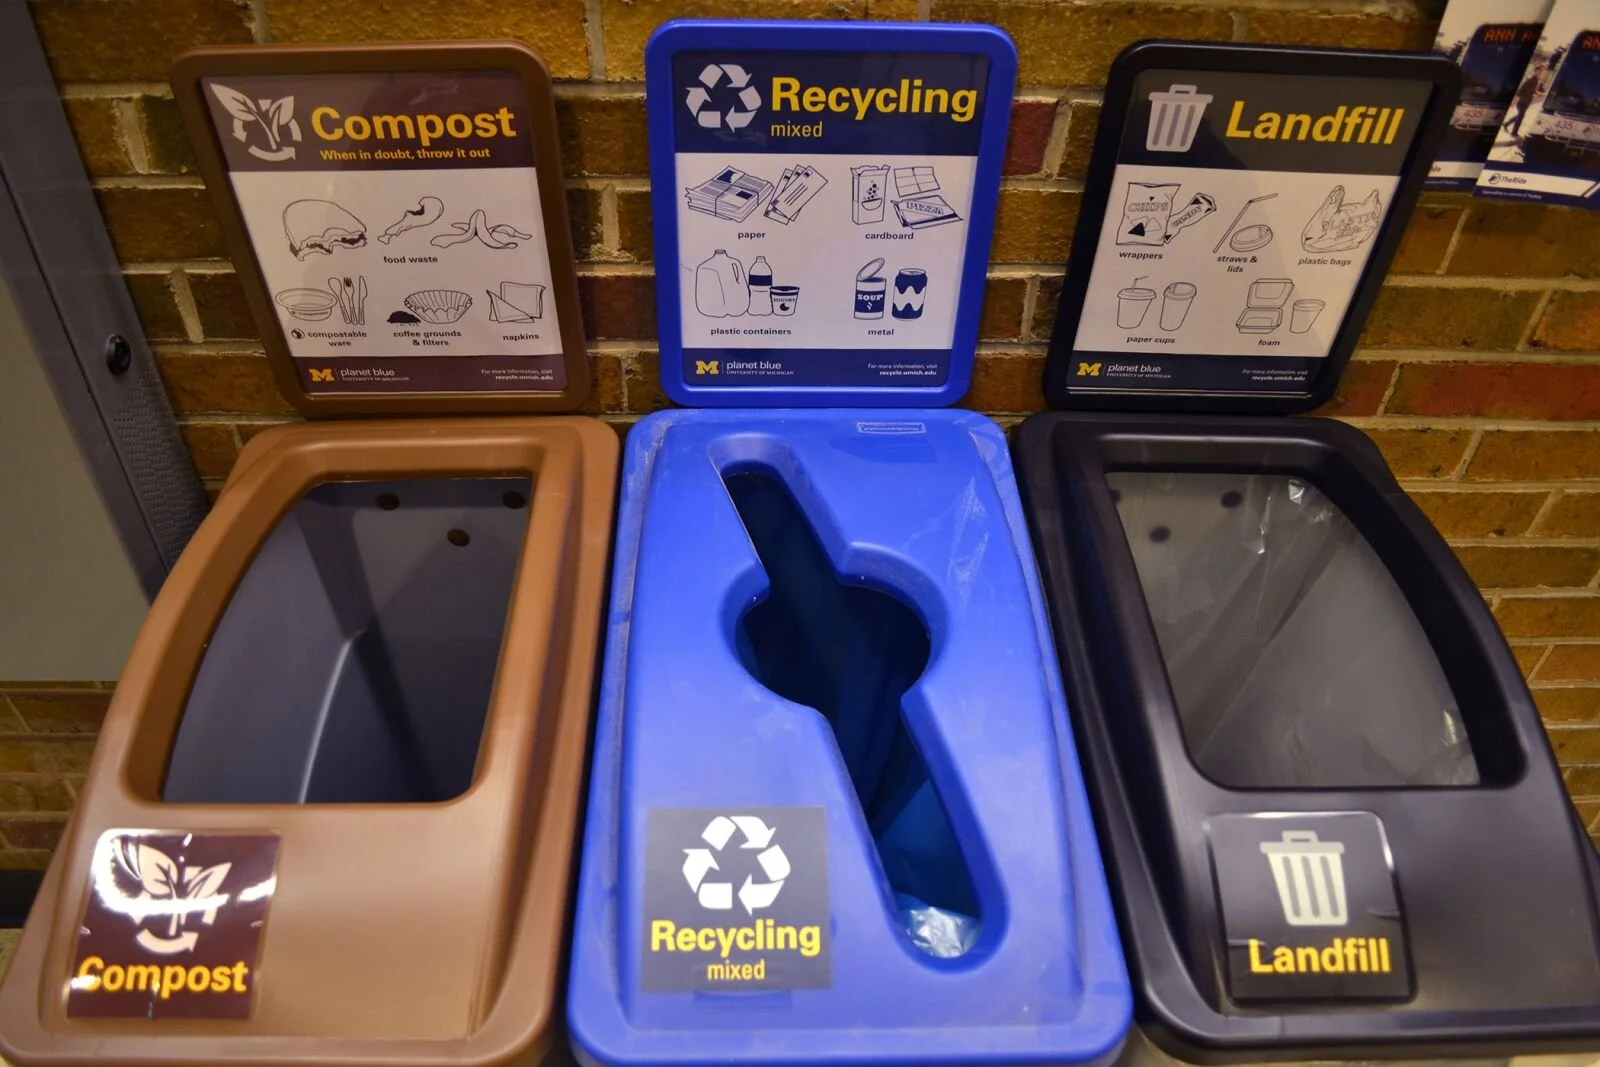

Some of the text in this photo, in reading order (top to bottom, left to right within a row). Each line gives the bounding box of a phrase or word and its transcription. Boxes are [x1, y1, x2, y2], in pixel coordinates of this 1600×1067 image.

[771, 76, 977, 122] Recycling
[311, 106, 517, 147] Compost
[1225, 100, 1404, 145] Landfill
[770, 121, 823, 138] mixed
[320, 148, 491, 161] When in doubt, throw it out
[737, 232, 766, 240] paper
[865, 231, 914, 240] cardboard
[383, 256, 438, 264] food waste
[1119, 251, 1163, 260] wrappers
[1216, 256, 1258, 264] straws &
[1297, 257, 1352, 266] plastic bags
[1227, 265, 1243, 273] lids
[857, 293, 884, 301] SOUP
[307, 330, 367, 339] compostable
[393, 330, 462, 339] coffee grounds
[710, 327, 792, 336] plastic containers
[867, 328, 895, 336] metal
[502, 333, 540, 342] napkins
[1126, 336, 1176, 345] paper cups
[412, 339, 449, 347] & filters
[1258, 339, 1280, 347] foam
[695, 360, 719, 375] M
[726, 360, 782, 371] planet blue
[1077, 362, 1102, 376] M
[1107, 363, 1162, 373] planet blue
[308, 368, 335, 382] M
[340, 367, 395, 377] planet blue
[651, 918, 821, 957] Recycling
[1248, 937, 1391, 974] Landfill
[707, 959, 766, 980] mixed
[77, 956, 249, 999] Compost
